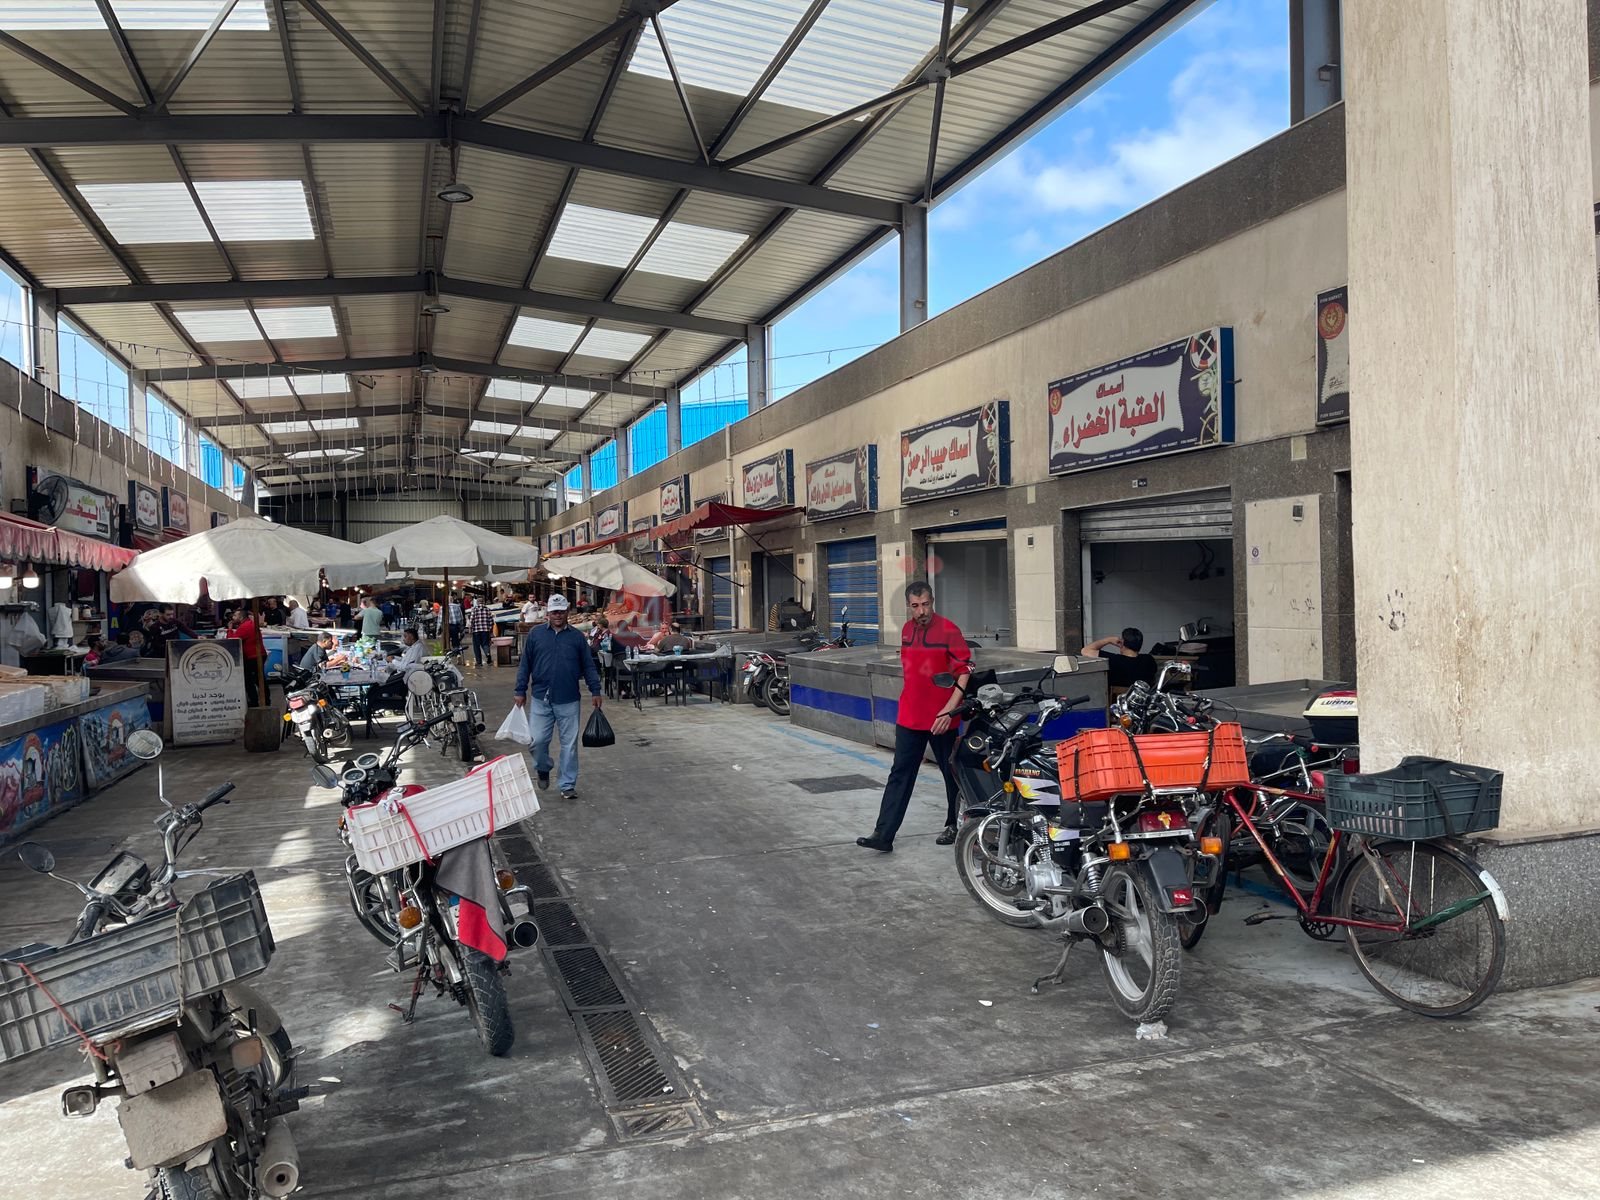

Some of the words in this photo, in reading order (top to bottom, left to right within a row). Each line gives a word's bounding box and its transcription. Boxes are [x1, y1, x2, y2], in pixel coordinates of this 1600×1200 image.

[1063, 403, 1116, 449] الخضراء
[1119, 390, 1166, 437] العتبة
[907, 444, 930, 477] الرحمن
[930, 446, 948, 472] حبيب
[948, 429, 972, 462] أسماك
